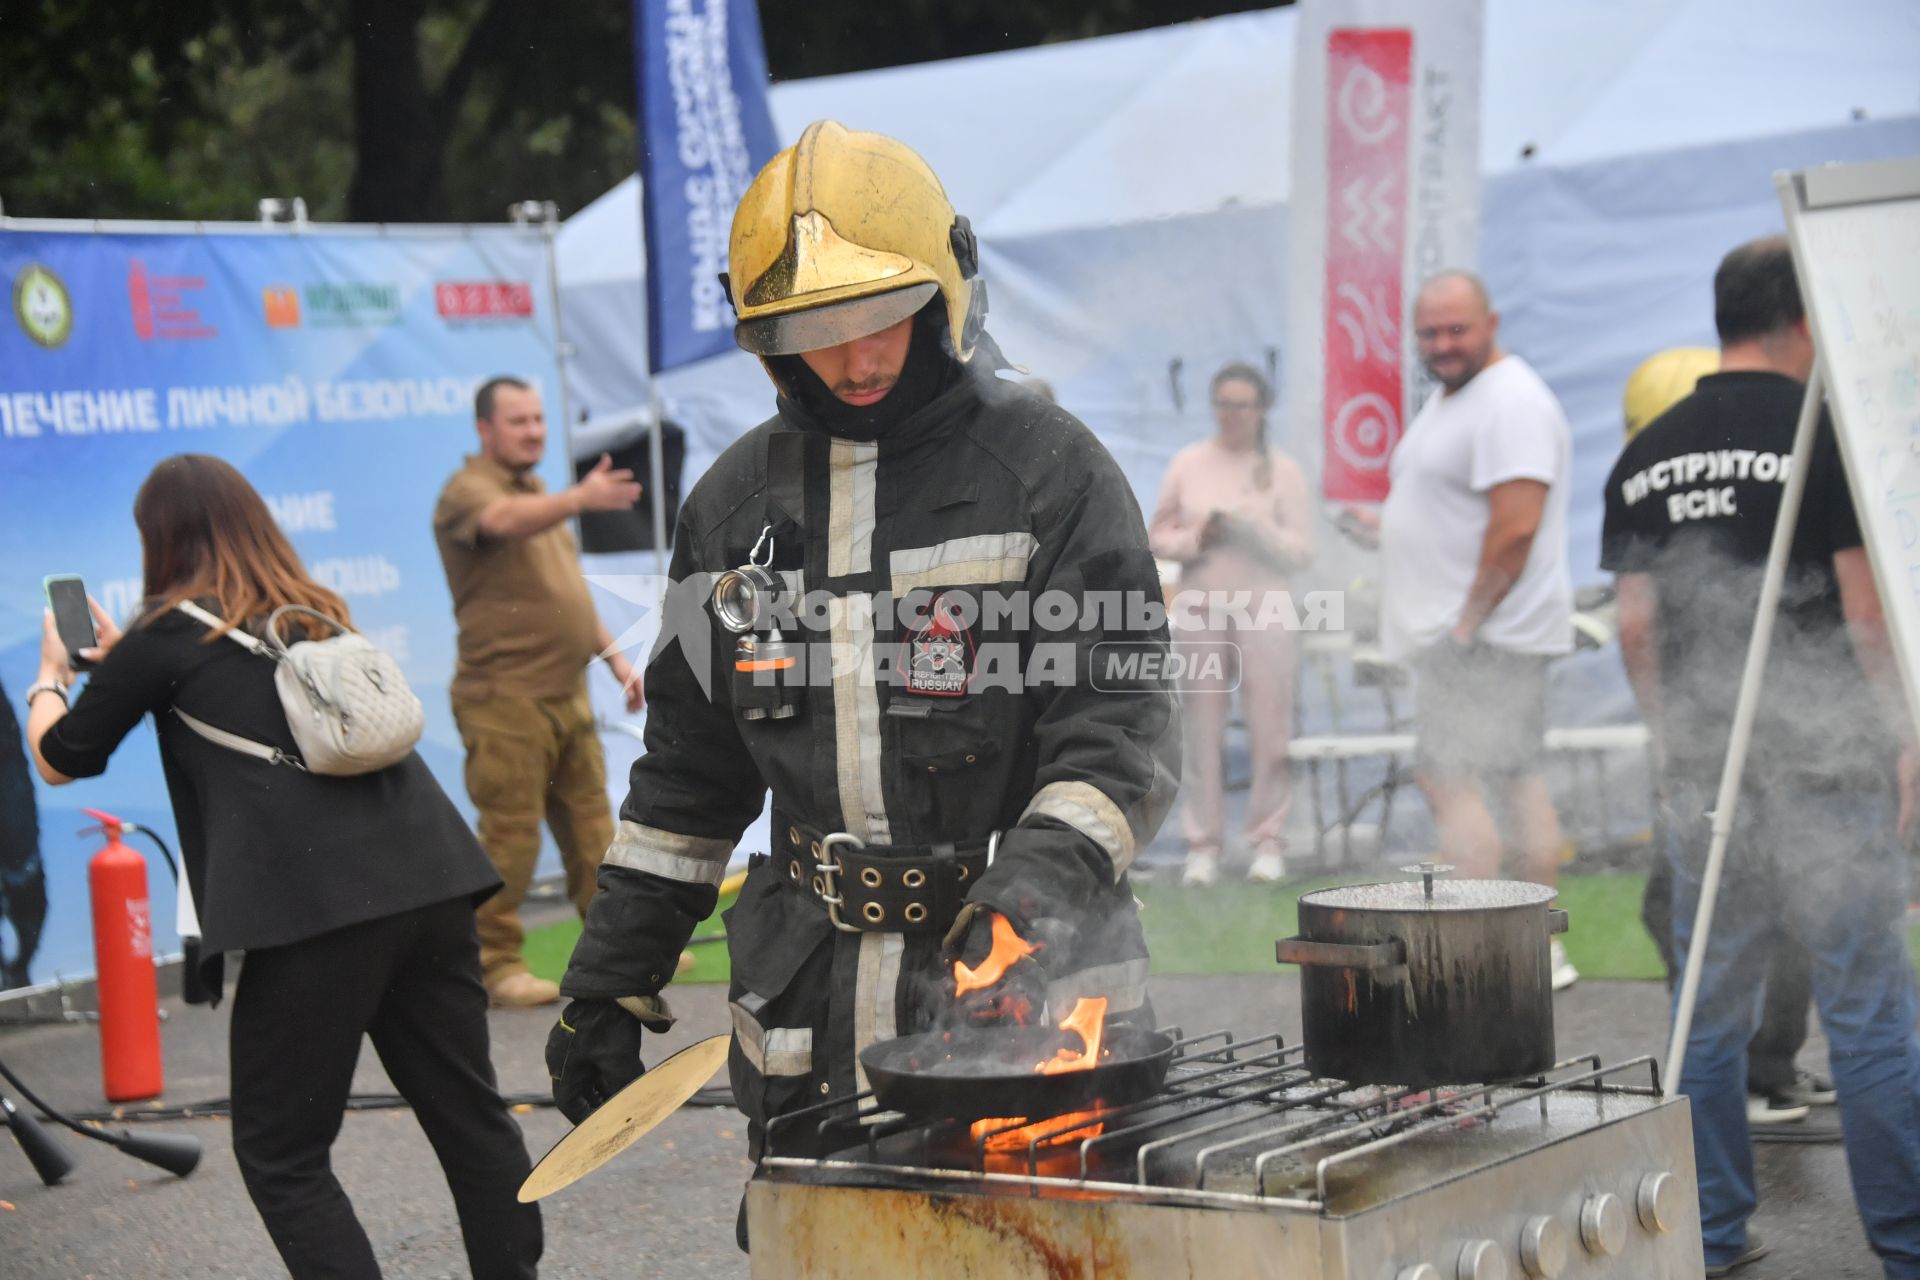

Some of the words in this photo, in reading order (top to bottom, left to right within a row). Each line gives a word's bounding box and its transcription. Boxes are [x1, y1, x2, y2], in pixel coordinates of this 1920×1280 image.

[167, 376, 309, 430] ЛИЧНОЙ
[908, 669, 966, 681] FIREFIGHTERS
[911, 679, 961, 691] RUSSIAN
